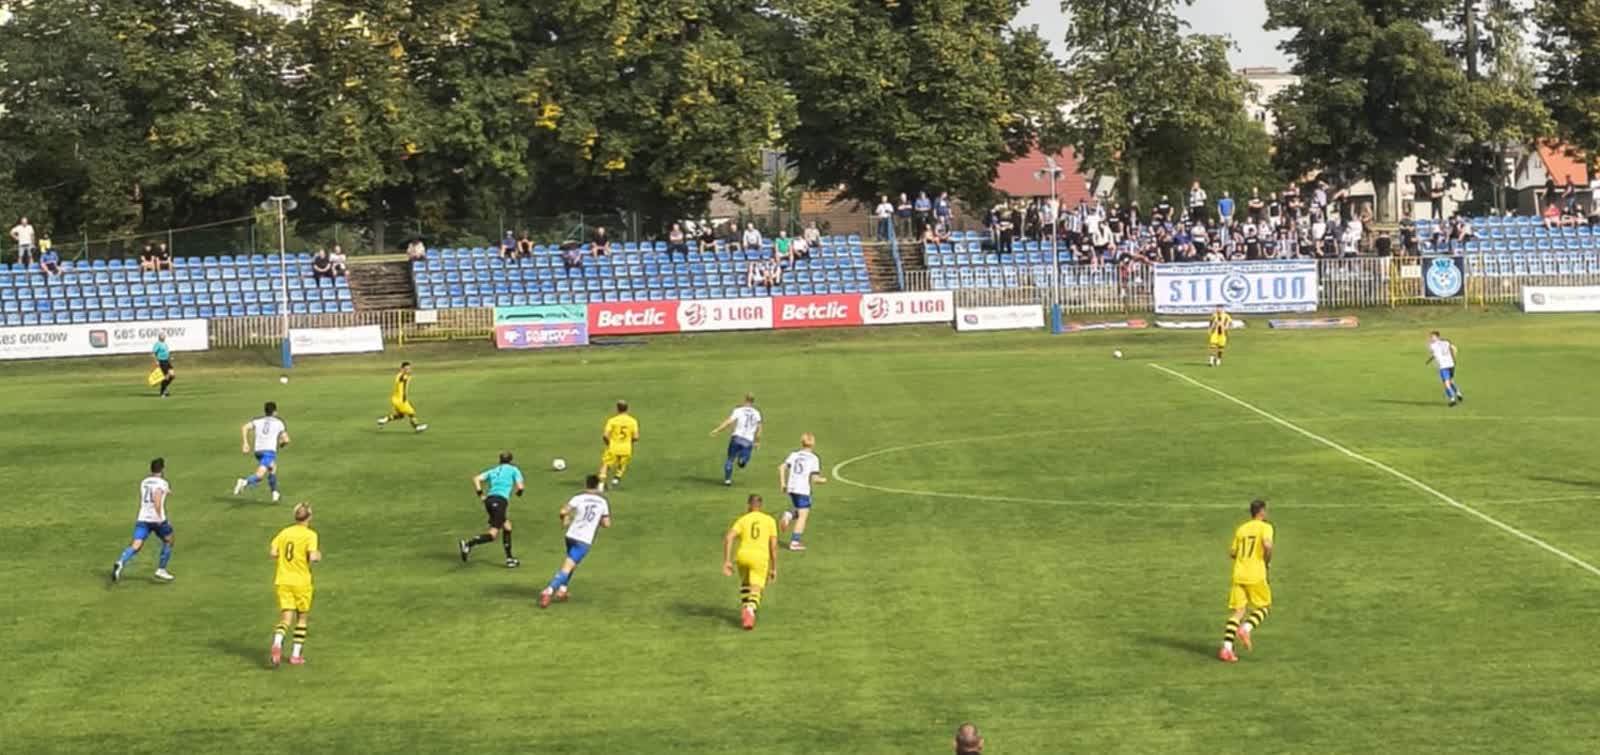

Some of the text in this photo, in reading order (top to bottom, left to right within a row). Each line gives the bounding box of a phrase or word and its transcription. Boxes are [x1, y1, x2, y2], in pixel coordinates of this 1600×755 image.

[713, 306, 763, 321] 3 LIGA
[782, 302, 848, 320] Betclic
[896, 299, 945, 314] 3 LIGA
[597, 308, 666, 327] Betclic
[0, 334, 17, 345] BS
[583, 504, 597, 522] 16
[751, 521, 760, 540] 6
[1242, 535, 1256, 558] 17
